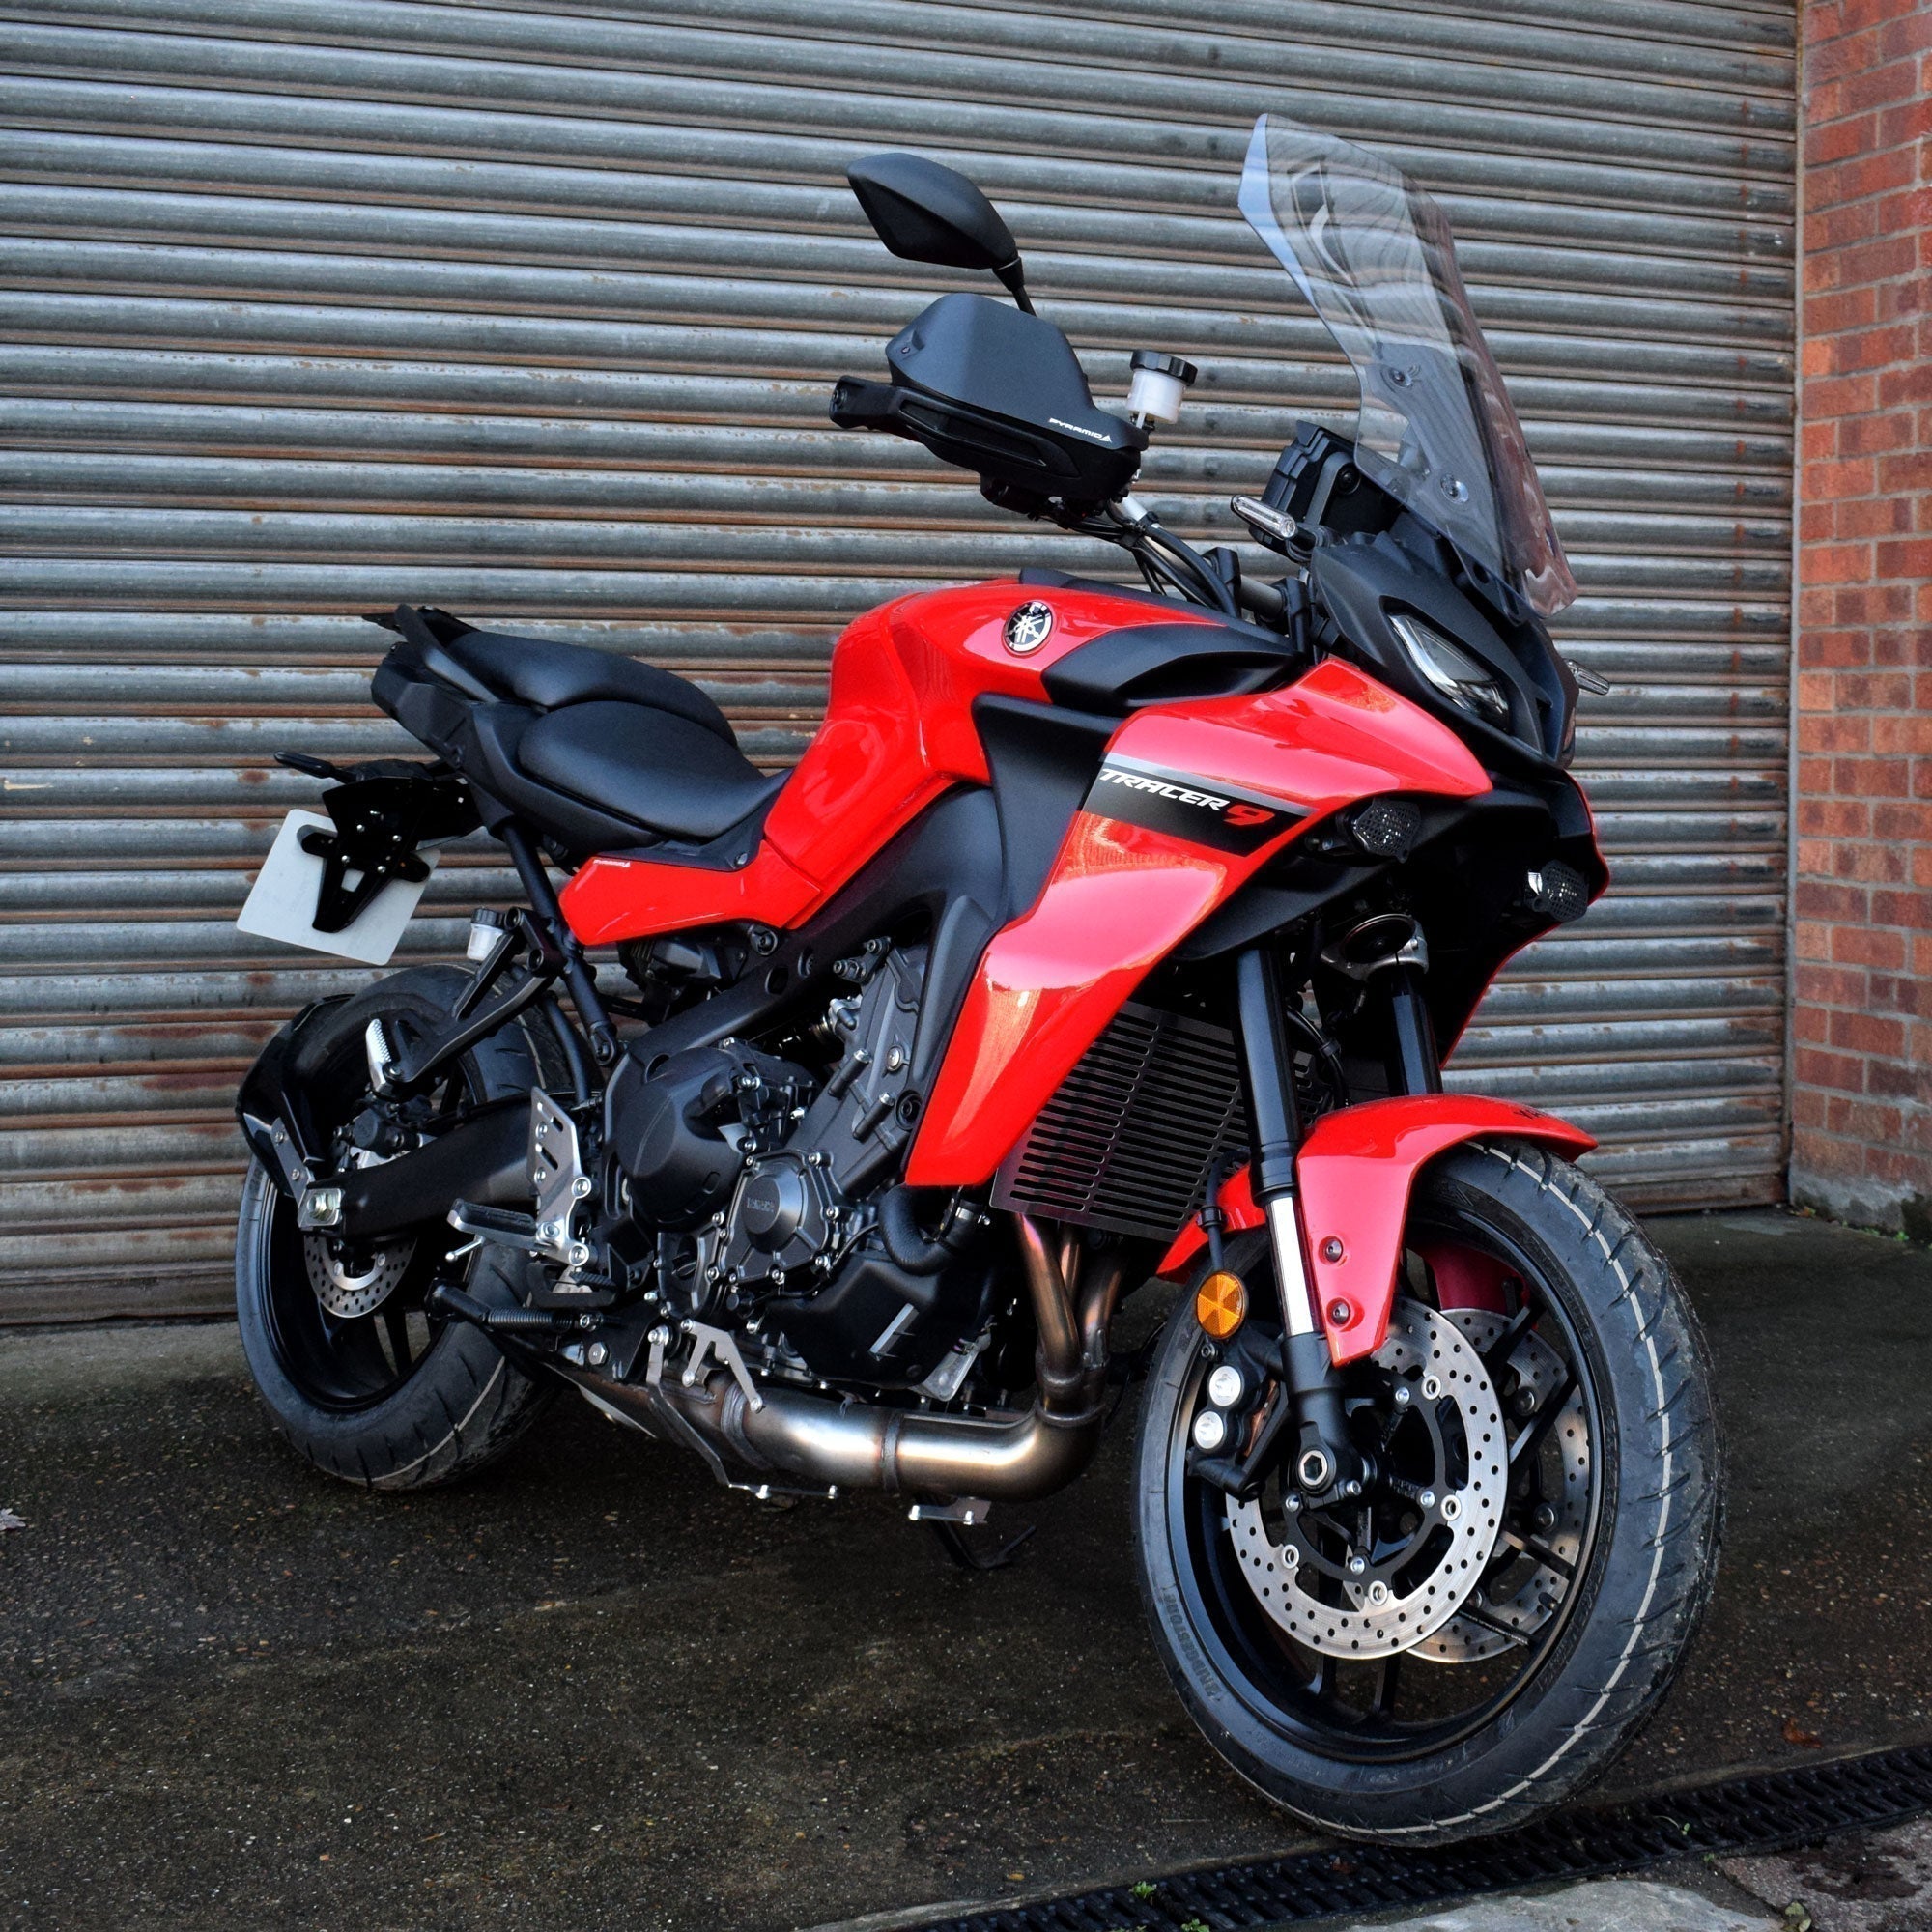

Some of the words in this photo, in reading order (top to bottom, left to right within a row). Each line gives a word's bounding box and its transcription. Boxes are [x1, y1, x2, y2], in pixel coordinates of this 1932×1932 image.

[1048, 417, 1104, 440] PYRAMID
[1099, 768, 1231, 811] TRACER
[1223, 804, 1276, 826] 9
